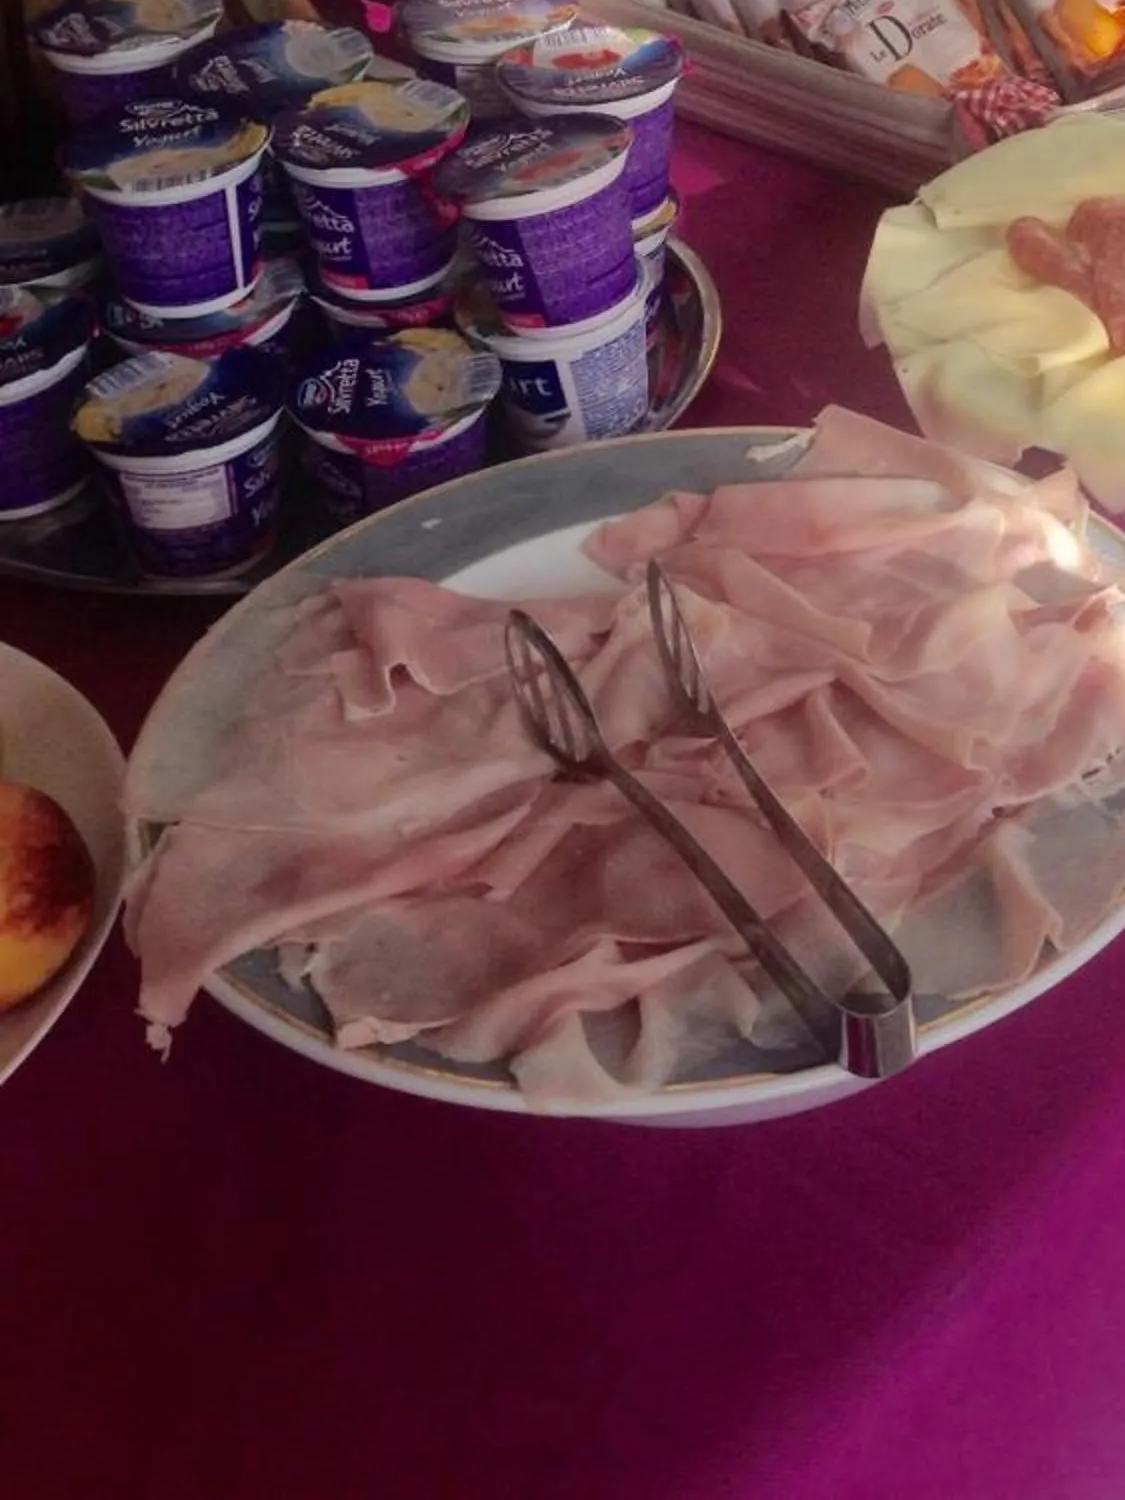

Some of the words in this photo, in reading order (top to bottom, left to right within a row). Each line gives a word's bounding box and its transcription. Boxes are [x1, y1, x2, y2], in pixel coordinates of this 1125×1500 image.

[118, 107, 220, 134] Silvretta
[132, 127, 200, 148] Yogurt
[326, 357, 361, 415] Silvretta
[366, 367, 393, 407] Yogurt
